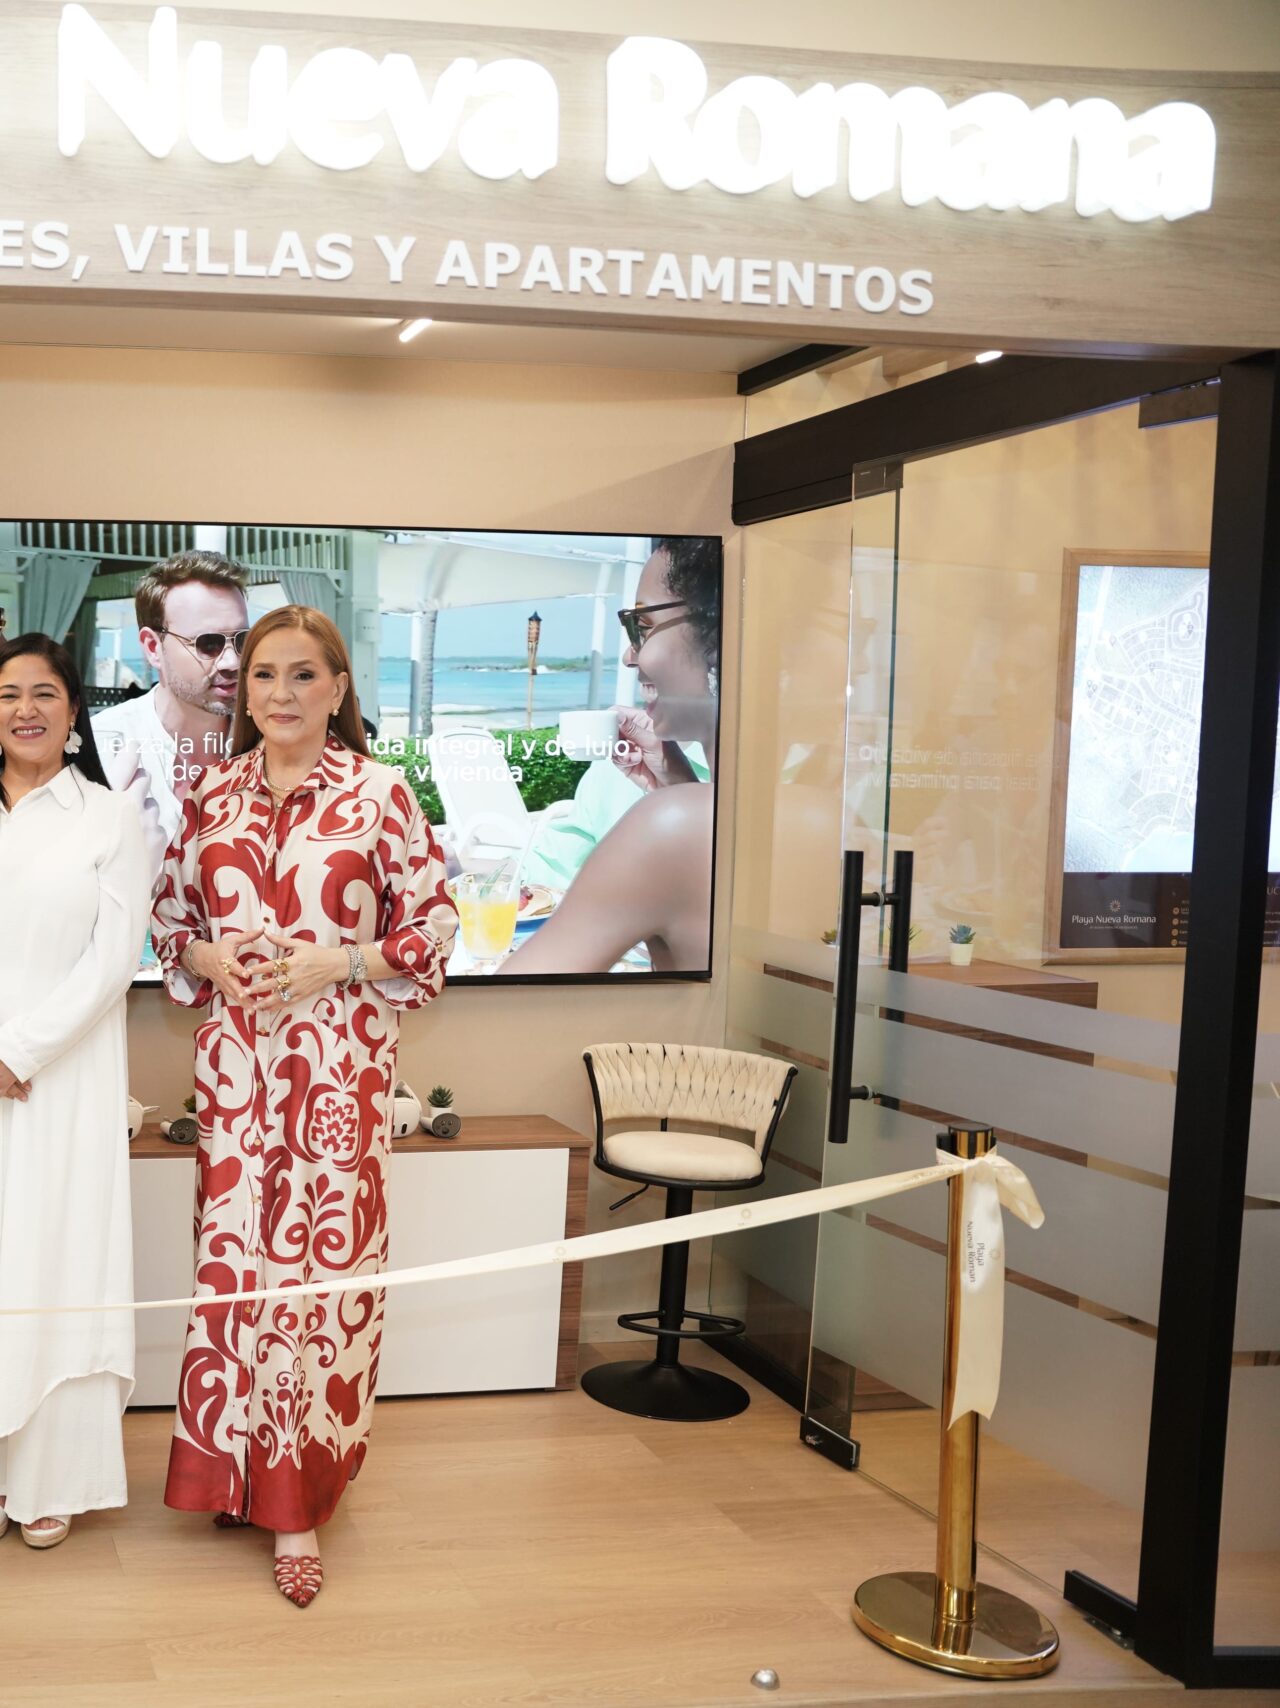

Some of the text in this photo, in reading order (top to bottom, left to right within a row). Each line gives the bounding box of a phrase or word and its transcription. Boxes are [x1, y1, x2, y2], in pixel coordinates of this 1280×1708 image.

[58, 3, 559, 179] Nueva
[606, 36, 1216, 221] Romana
[114, 224, 354, 281] VILLAS
[375, 236, 416, 283] Y
[436, 239, 935, 315] APARTAMENTOS
[174, 731, 194, 754] la
[415, 733, 512, 759] integral
[522, 739, 537, 760] y
[545, 734, 576, 756] de
[585, 734, 630, 760] lujo
[415, 761, 523, 782] vivienda
[1072, 914, 1157, 926] Playa Nueva Romana
